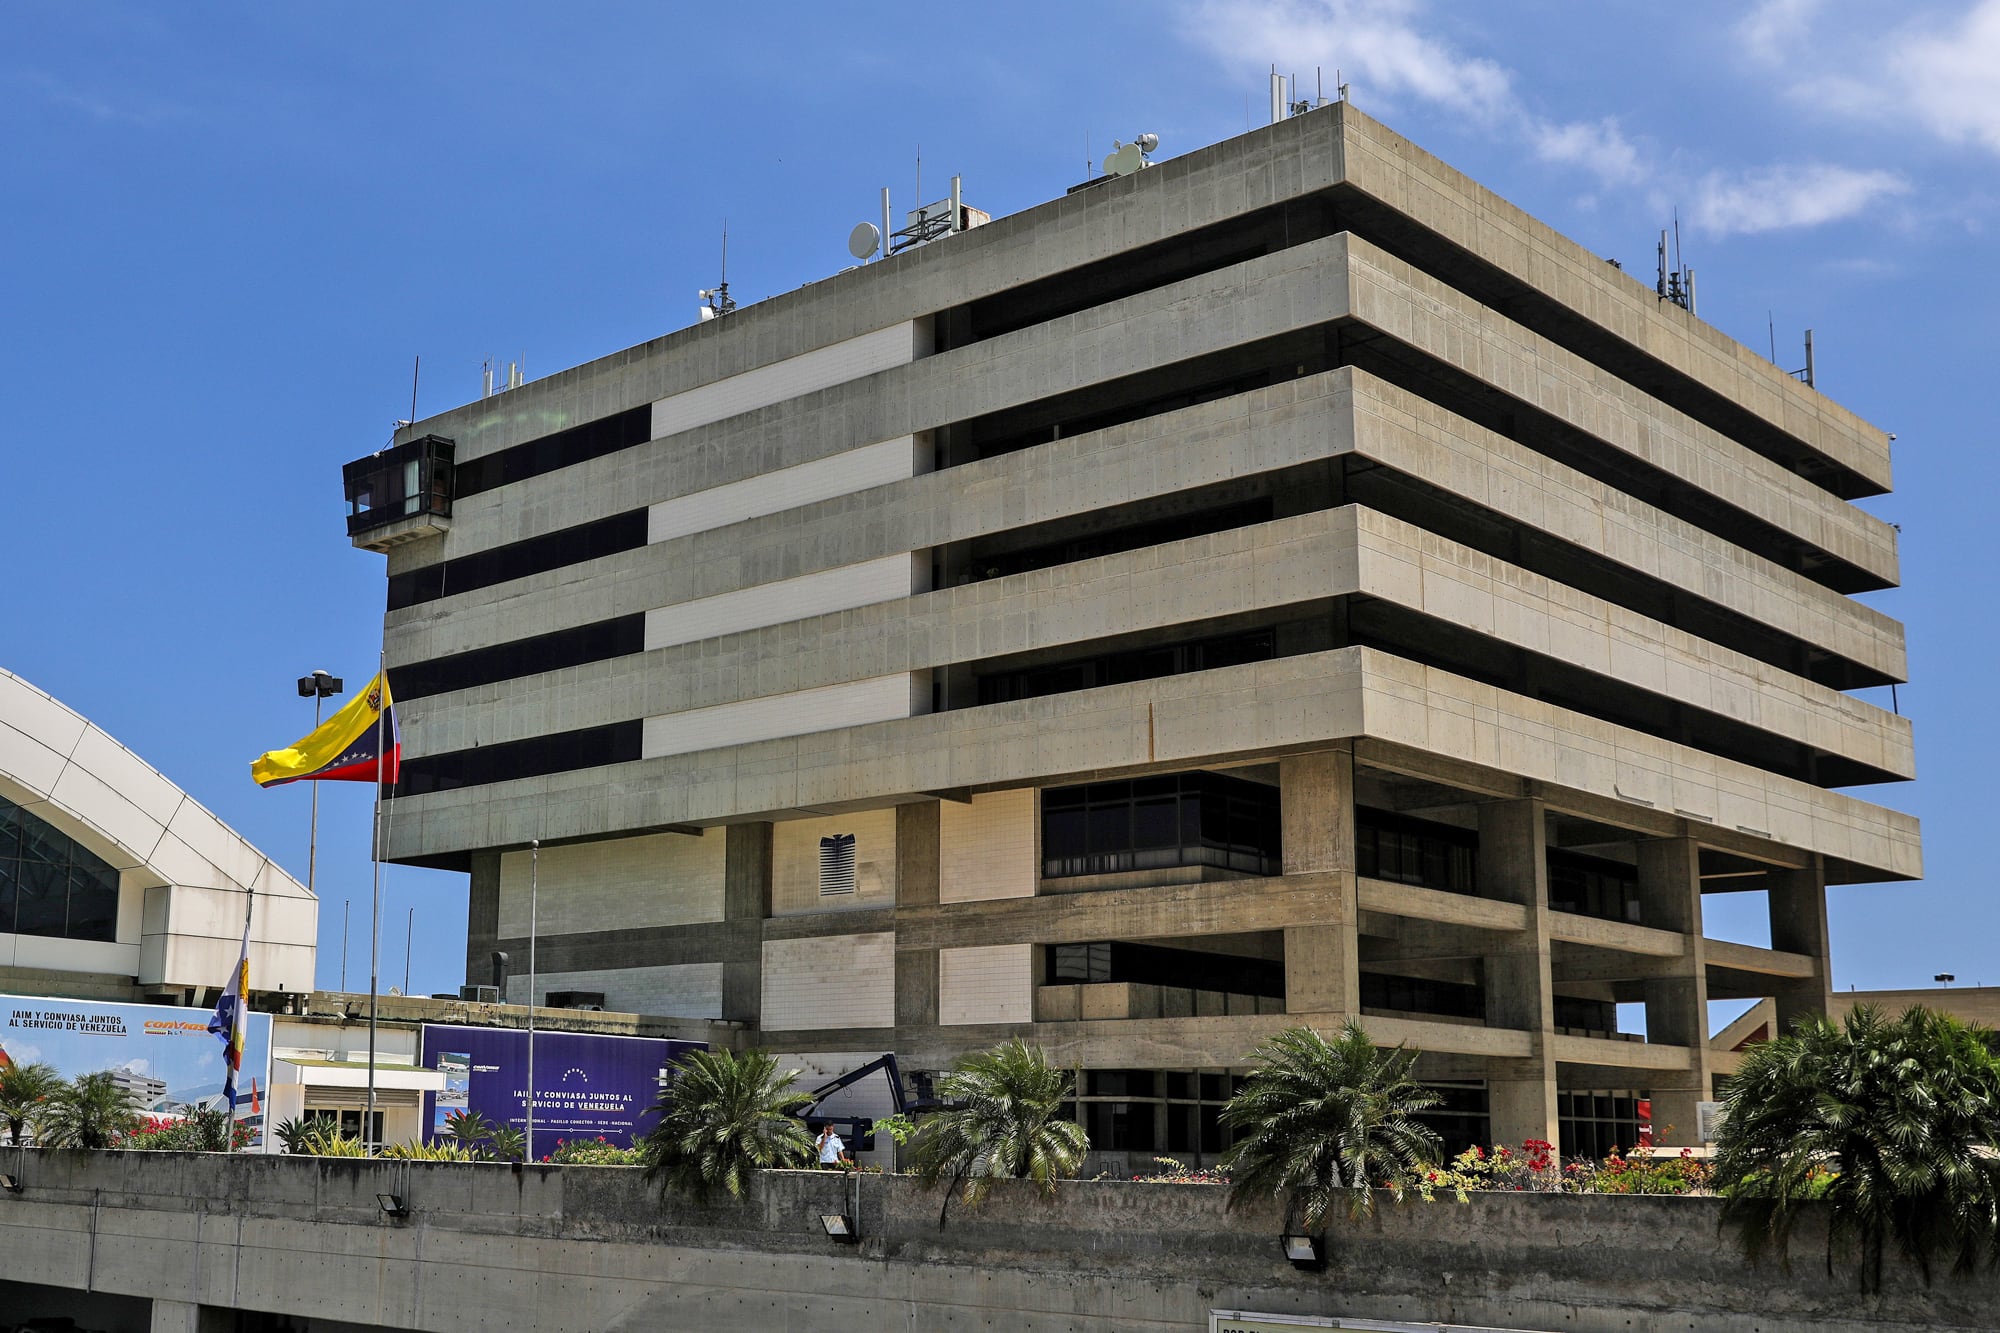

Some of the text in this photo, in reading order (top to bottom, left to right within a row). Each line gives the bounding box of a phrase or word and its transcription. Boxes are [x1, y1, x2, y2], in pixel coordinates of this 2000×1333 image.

[12, 1010, 121, 1025] IAIM Y CONVIASA JUNTOS
[9, 1018, 127, 1033] AL SERVICIO DE VENEZUELA
[535, 1090, 541, 1098] Y
[544, 1091, 586, 1100] CONVIASA
[589, 1093, 620, 1101] JUNTOS
[622, 1094, 633, 1102] AL
[521, 1100, 625, 1110] SRVICIO DE VENEZUELA
